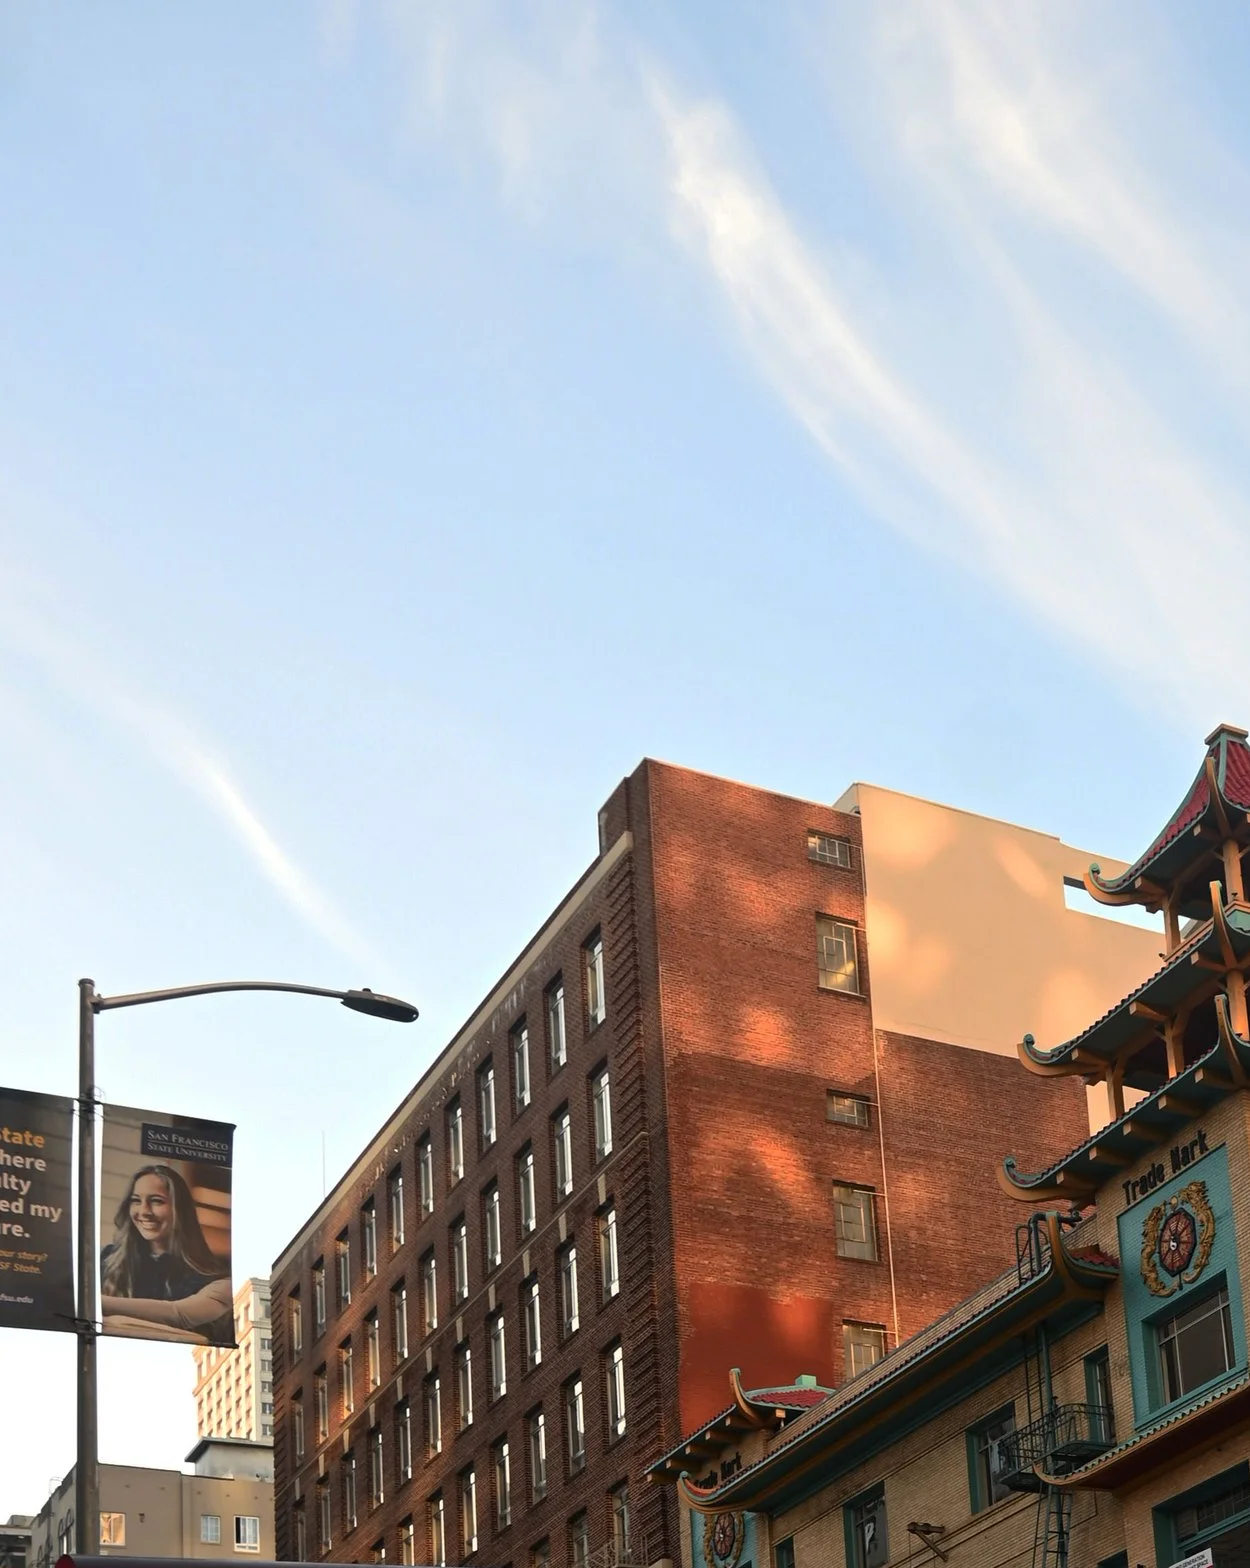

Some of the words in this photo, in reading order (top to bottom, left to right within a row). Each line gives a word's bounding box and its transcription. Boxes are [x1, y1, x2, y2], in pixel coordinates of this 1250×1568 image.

[0, 1127, 45, 1149] tate
[147, 1129, 169, 1141] SAN
[171, 1134, 229, 1151] FRANCISCO
[147, 1142, 174, 1154] STATE
[175, 1146, 227, 1162] UNIVERSITY
[1122, 1163, 1165, 1206] Trade
[1170, 1130, 1209, 1174] Mark
[0, 1172, 31, 1195] lty
[30, 1204, 62, 1223] my
